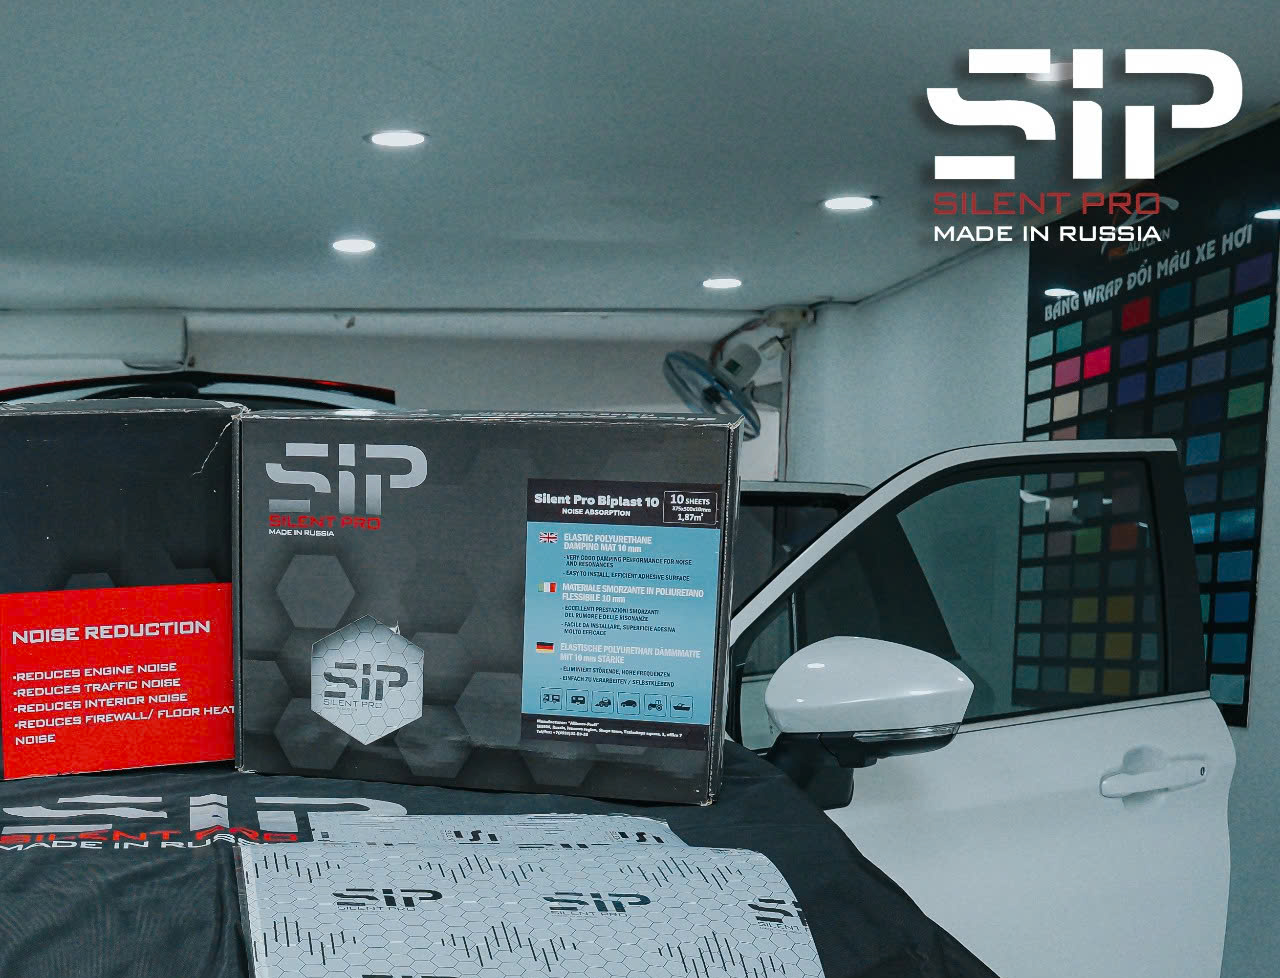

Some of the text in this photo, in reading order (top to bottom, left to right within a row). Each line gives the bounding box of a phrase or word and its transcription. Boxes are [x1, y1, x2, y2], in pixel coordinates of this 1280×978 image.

[1083, 277, 1122, 307] WRAP
[1195, 240, 1216, 264] XE
[534, 493, 660, 508] Silent Pro Biplast 10
[670, 494, 684, 504] 10
[269, 514, 381, 531] SILENT PRO
[304, 529, 334, 537] RUSSIA
[595, 535, 652, 544] POLYURETHANE
[564, 542, 599, 551] DAMPING
[601, 543, 616, 551] MAT
[618, 544, 626, 552] 10
[562, 583, 600, 593] MATERIALE
[602, 585, 645, 594] SMORZANTE
[656, 588, 704, 597] POLIURETANO
[562, 593, 600, 601] FLESSIBILE
[12, 620, 211, 645] NOISE REDUCTION
[560, 643, 602, 653] ELASTISCHE
[603, 645, 653, 655] POLYURETHAN
[84, 665, 134, 677] ENGINE
[138, 663, 177, 673] NOISE
[85, 681, 137, 693] TRAFFIC
[141, 678, 181, 689] NOISE
[85, 696, 145, 709] INTERIOR
[148, 693, 188, 704] NOISE
[324, 699, 359, 707] SILENT
[85, 709, 154, 723] FIREWALL/
[158, 707, 200, 719] FLOOR
[204, 705, 234, 715] HEAT
[15, 734, 56, 745] NOISE
[0, 829, 181, 845] SILENT
[114, 840, 149, 849] IN
